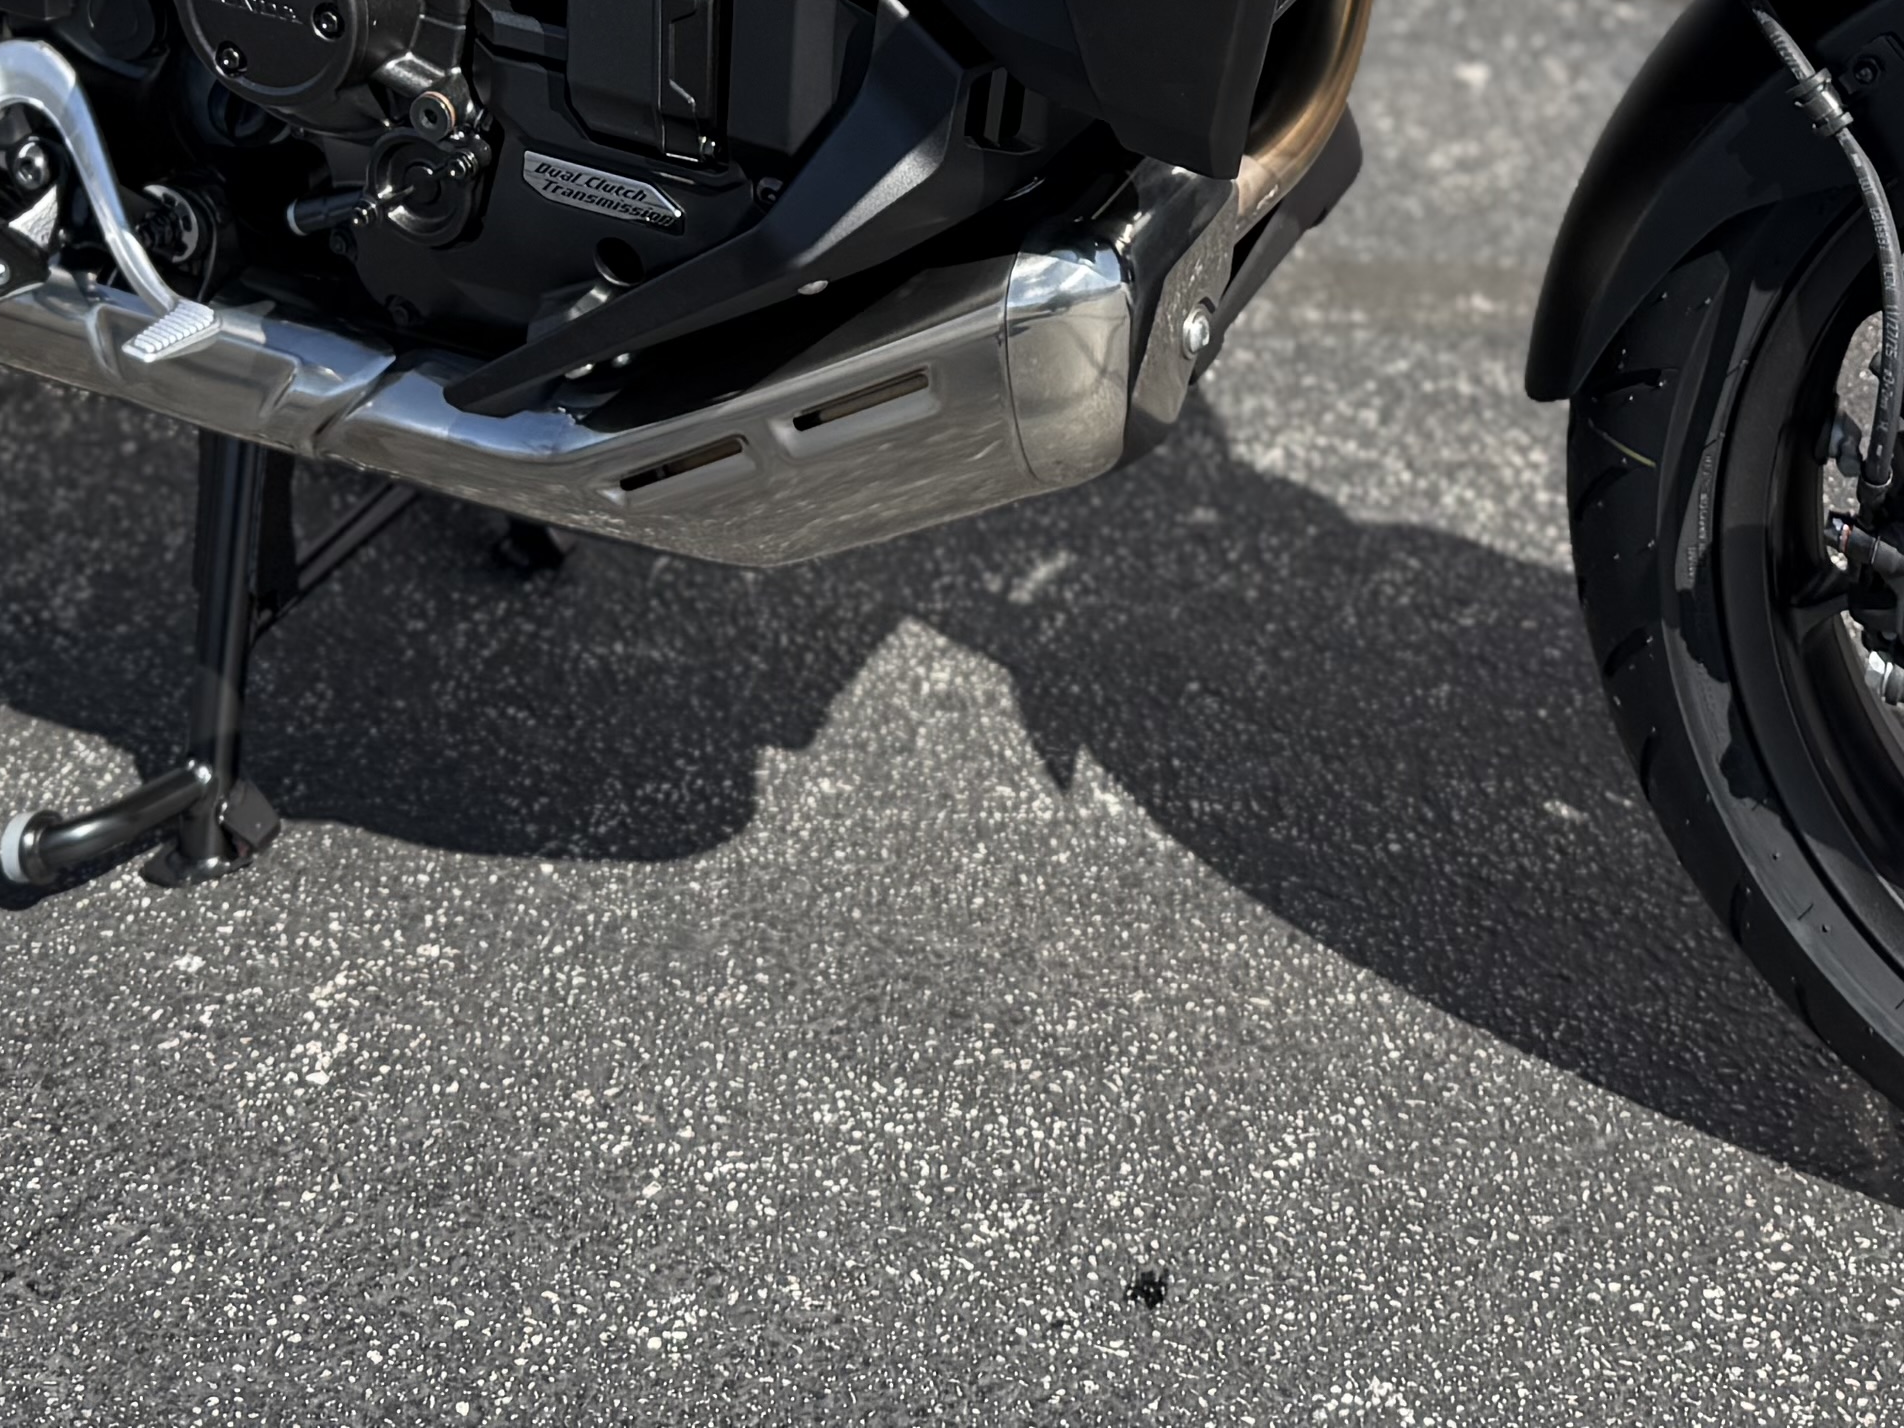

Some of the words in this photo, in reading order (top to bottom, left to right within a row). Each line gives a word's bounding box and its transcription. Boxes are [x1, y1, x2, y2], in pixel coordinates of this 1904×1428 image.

[533, 161, 584, 185] Dual
[584, 174, 649, 203] Clutch
[541, 177, 677, 228] Transmission
